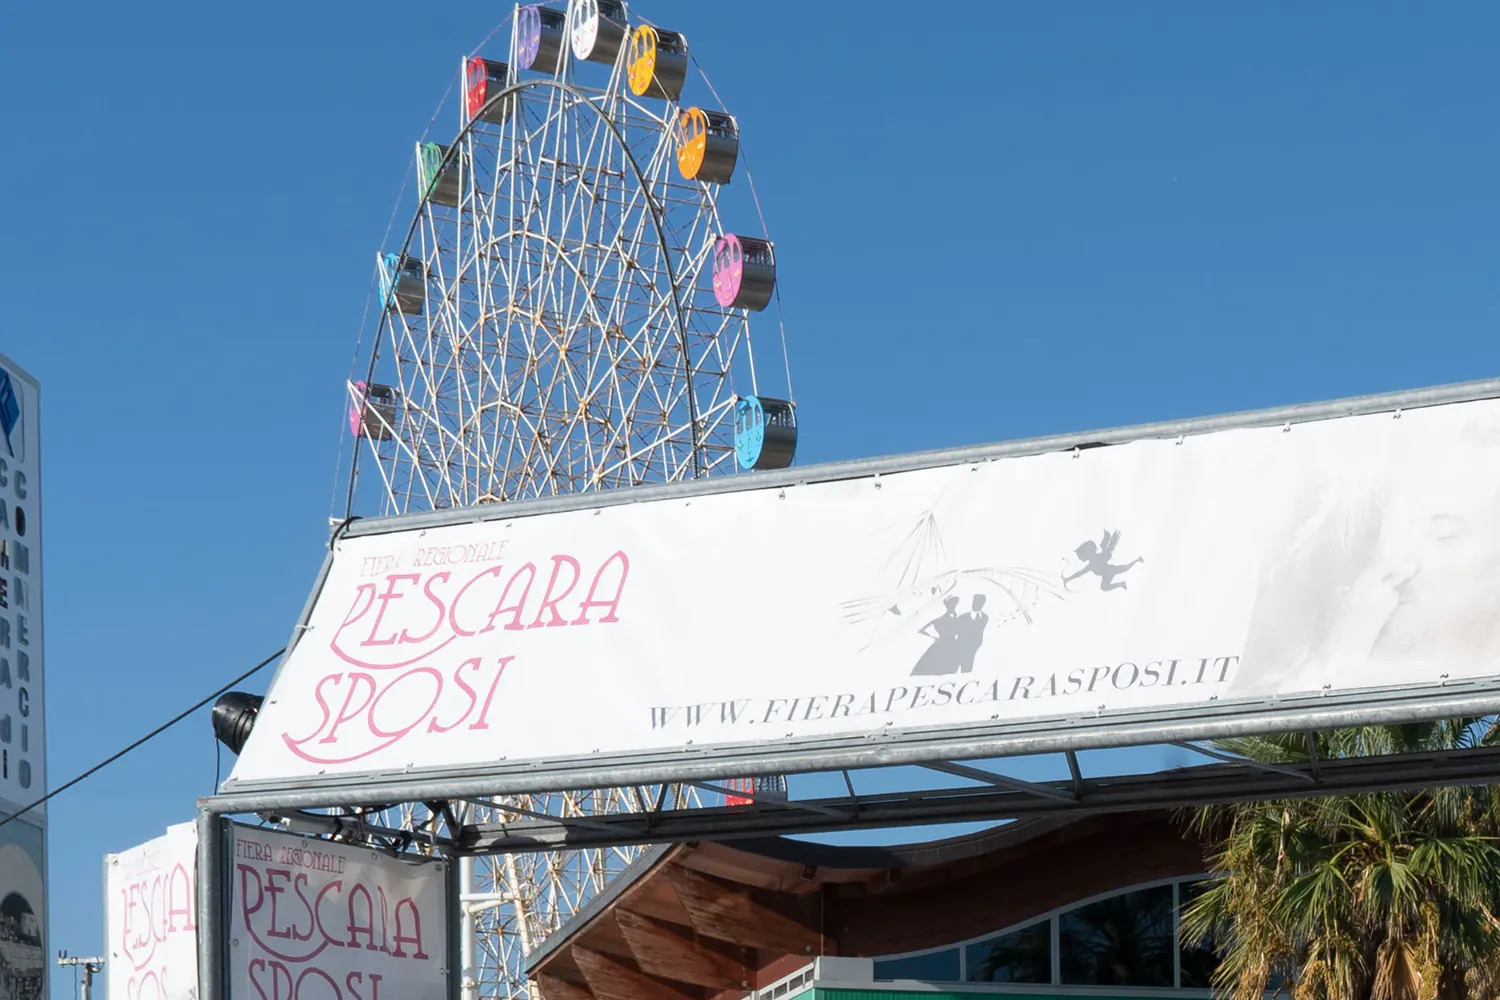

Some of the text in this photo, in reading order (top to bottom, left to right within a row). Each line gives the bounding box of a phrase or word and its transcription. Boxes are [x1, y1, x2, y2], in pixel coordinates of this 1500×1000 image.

[412, 539, 510, 567] REGIONALE
[14, 469, 32, 790] COMMERCIO
[330, 550, 630, 670] PESCARA
[281, 655, 516, 765] SPOSI
[648, 655, 1241, 731] WWW.FIERAPESCARASPOSI.IT
[236, 838, 347, 875] FIERA REGIONALE
